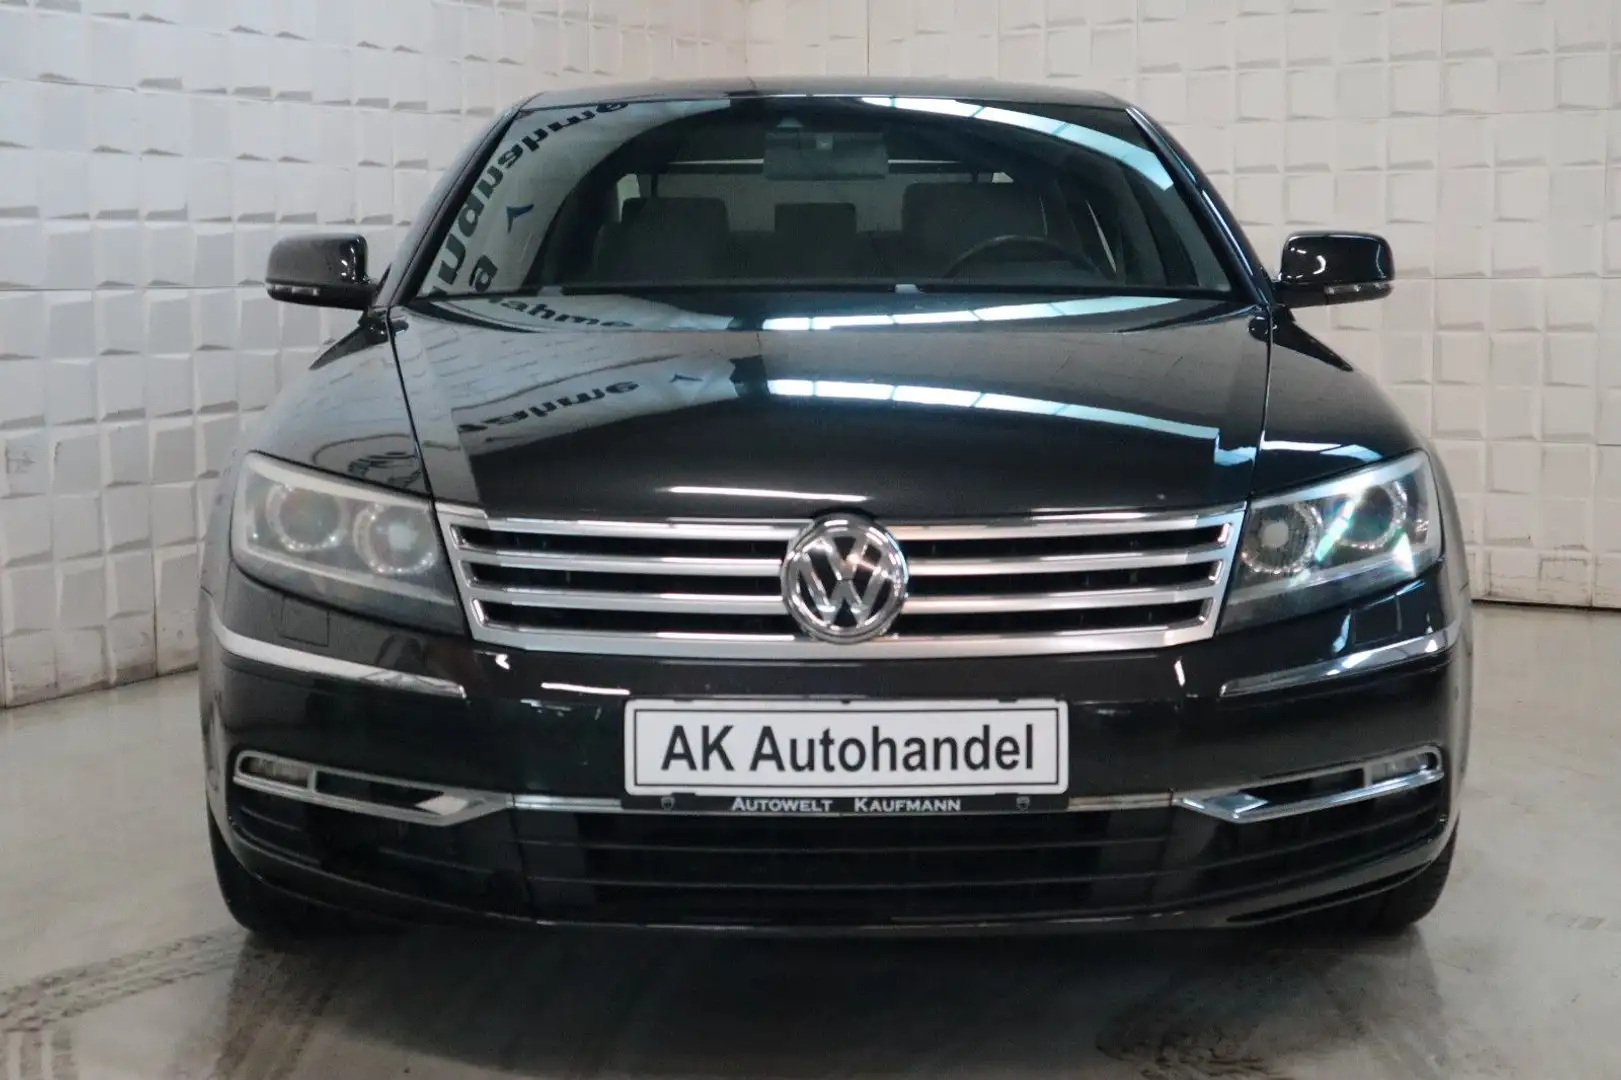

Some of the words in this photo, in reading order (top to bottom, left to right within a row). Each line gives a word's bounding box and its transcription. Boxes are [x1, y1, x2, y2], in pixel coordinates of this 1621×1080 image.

[661, 724, 735, 771] AK
[749, 723, 1034, 772] Autohandel
[731, 797, 833, 813] AUTOWELT
[853, 797, 961, 813] KAUFMANN
